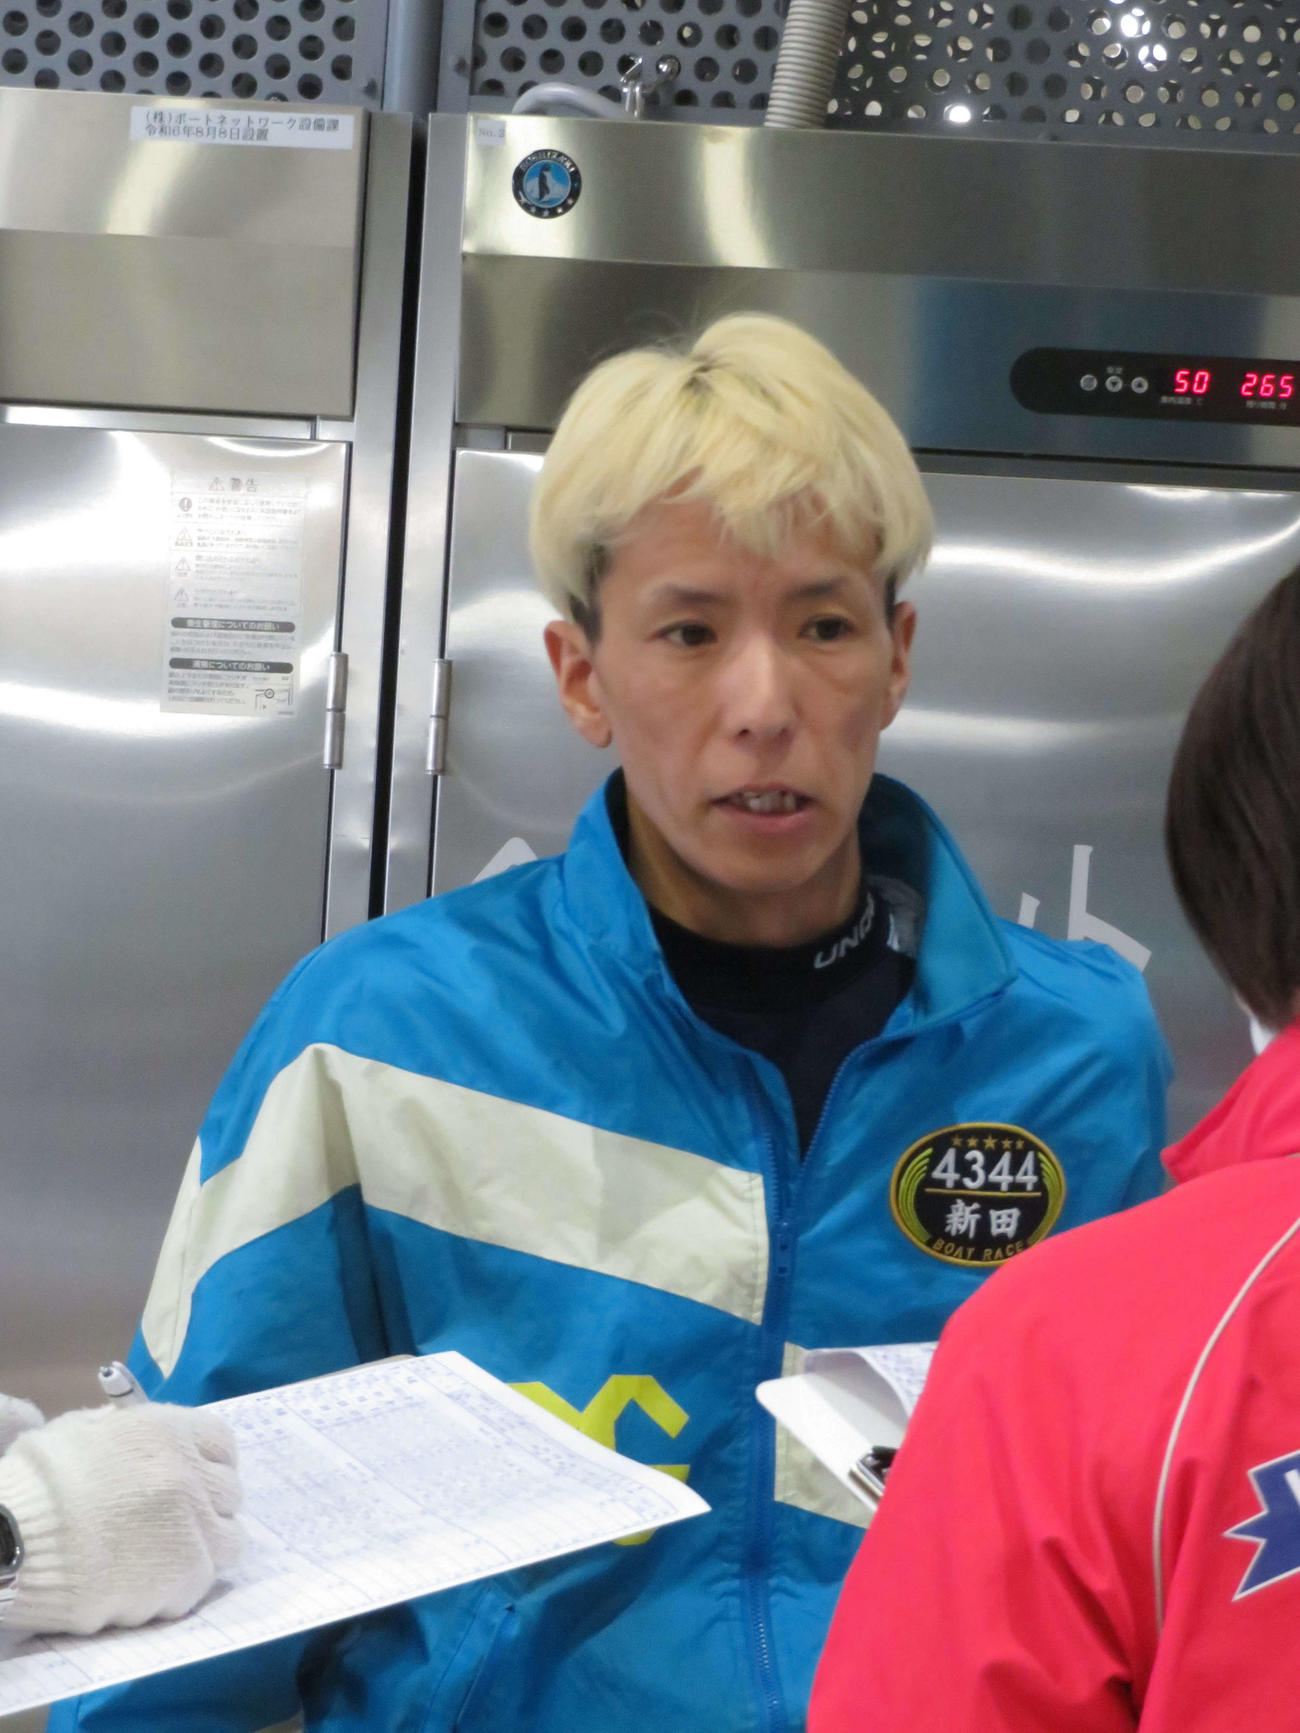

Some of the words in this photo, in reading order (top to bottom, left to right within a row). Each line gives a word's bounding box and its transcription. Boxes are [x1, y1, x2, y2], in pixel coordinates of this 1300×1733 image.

[1174, 369, 1210, 394] 50
[1240, 372, 1295, 399] 265
[931, 1148, 1039, 1192] 4344
[944, 1199, 1021, 1239] 新田
[932, 1239, 975, 1261] BOAT
[982, 1240, 1024, 1261] RACE
